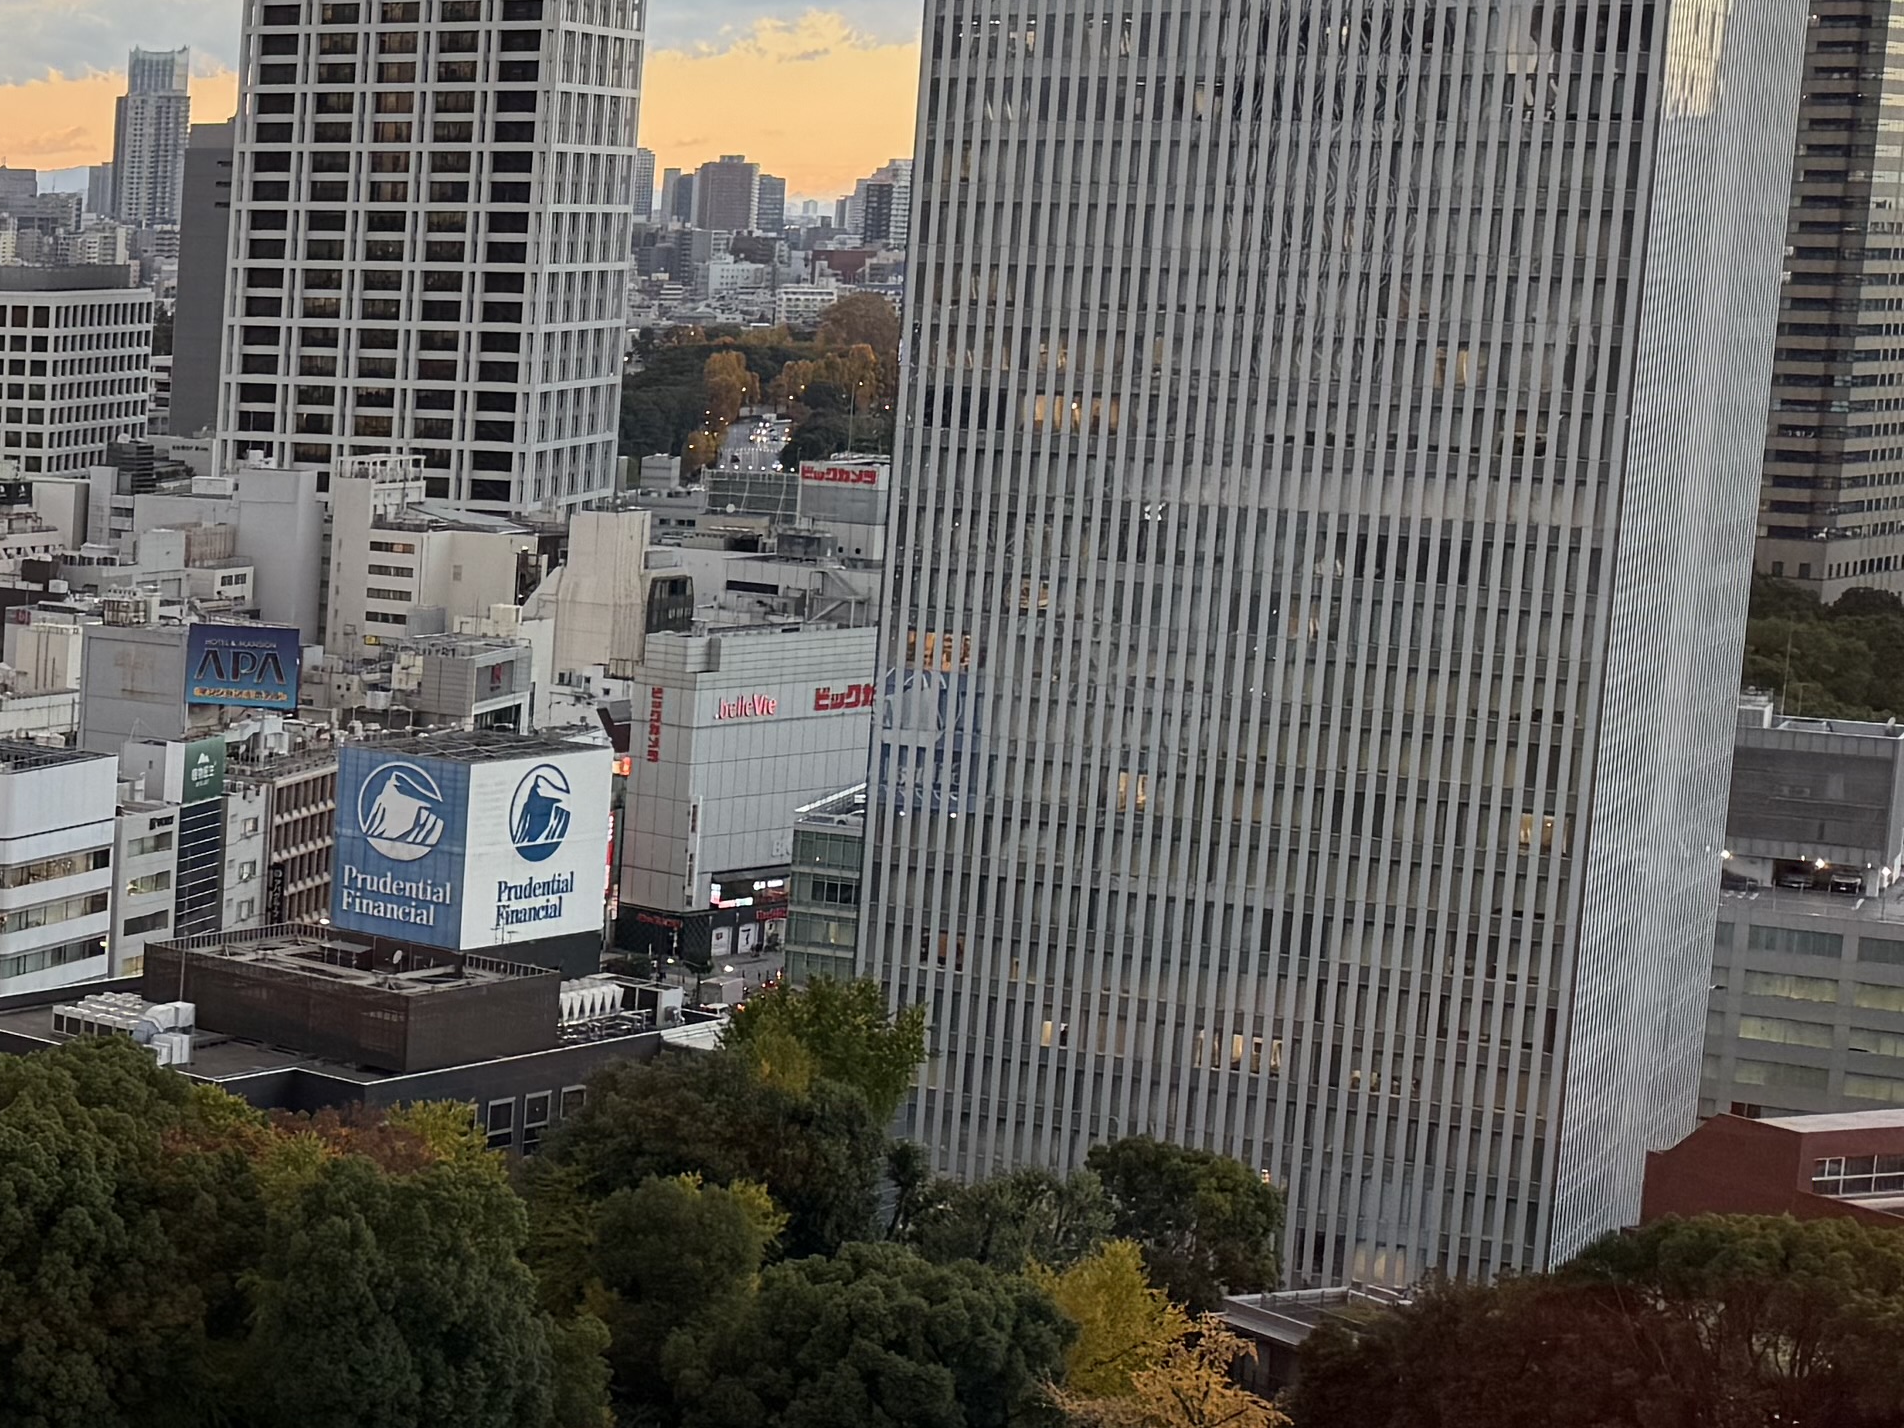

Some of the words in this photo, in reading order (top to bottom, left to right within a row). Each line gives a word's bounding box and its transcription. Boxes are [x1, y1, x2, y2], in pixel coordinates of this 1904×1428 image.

[194, 647, 287, 685] APA
[342, 864, 451, 905] Prudential
[496, 870, 575, 903] Prudential
[341, 888, 435, 927] Financial
[495, 895, 563, 927] Financial
